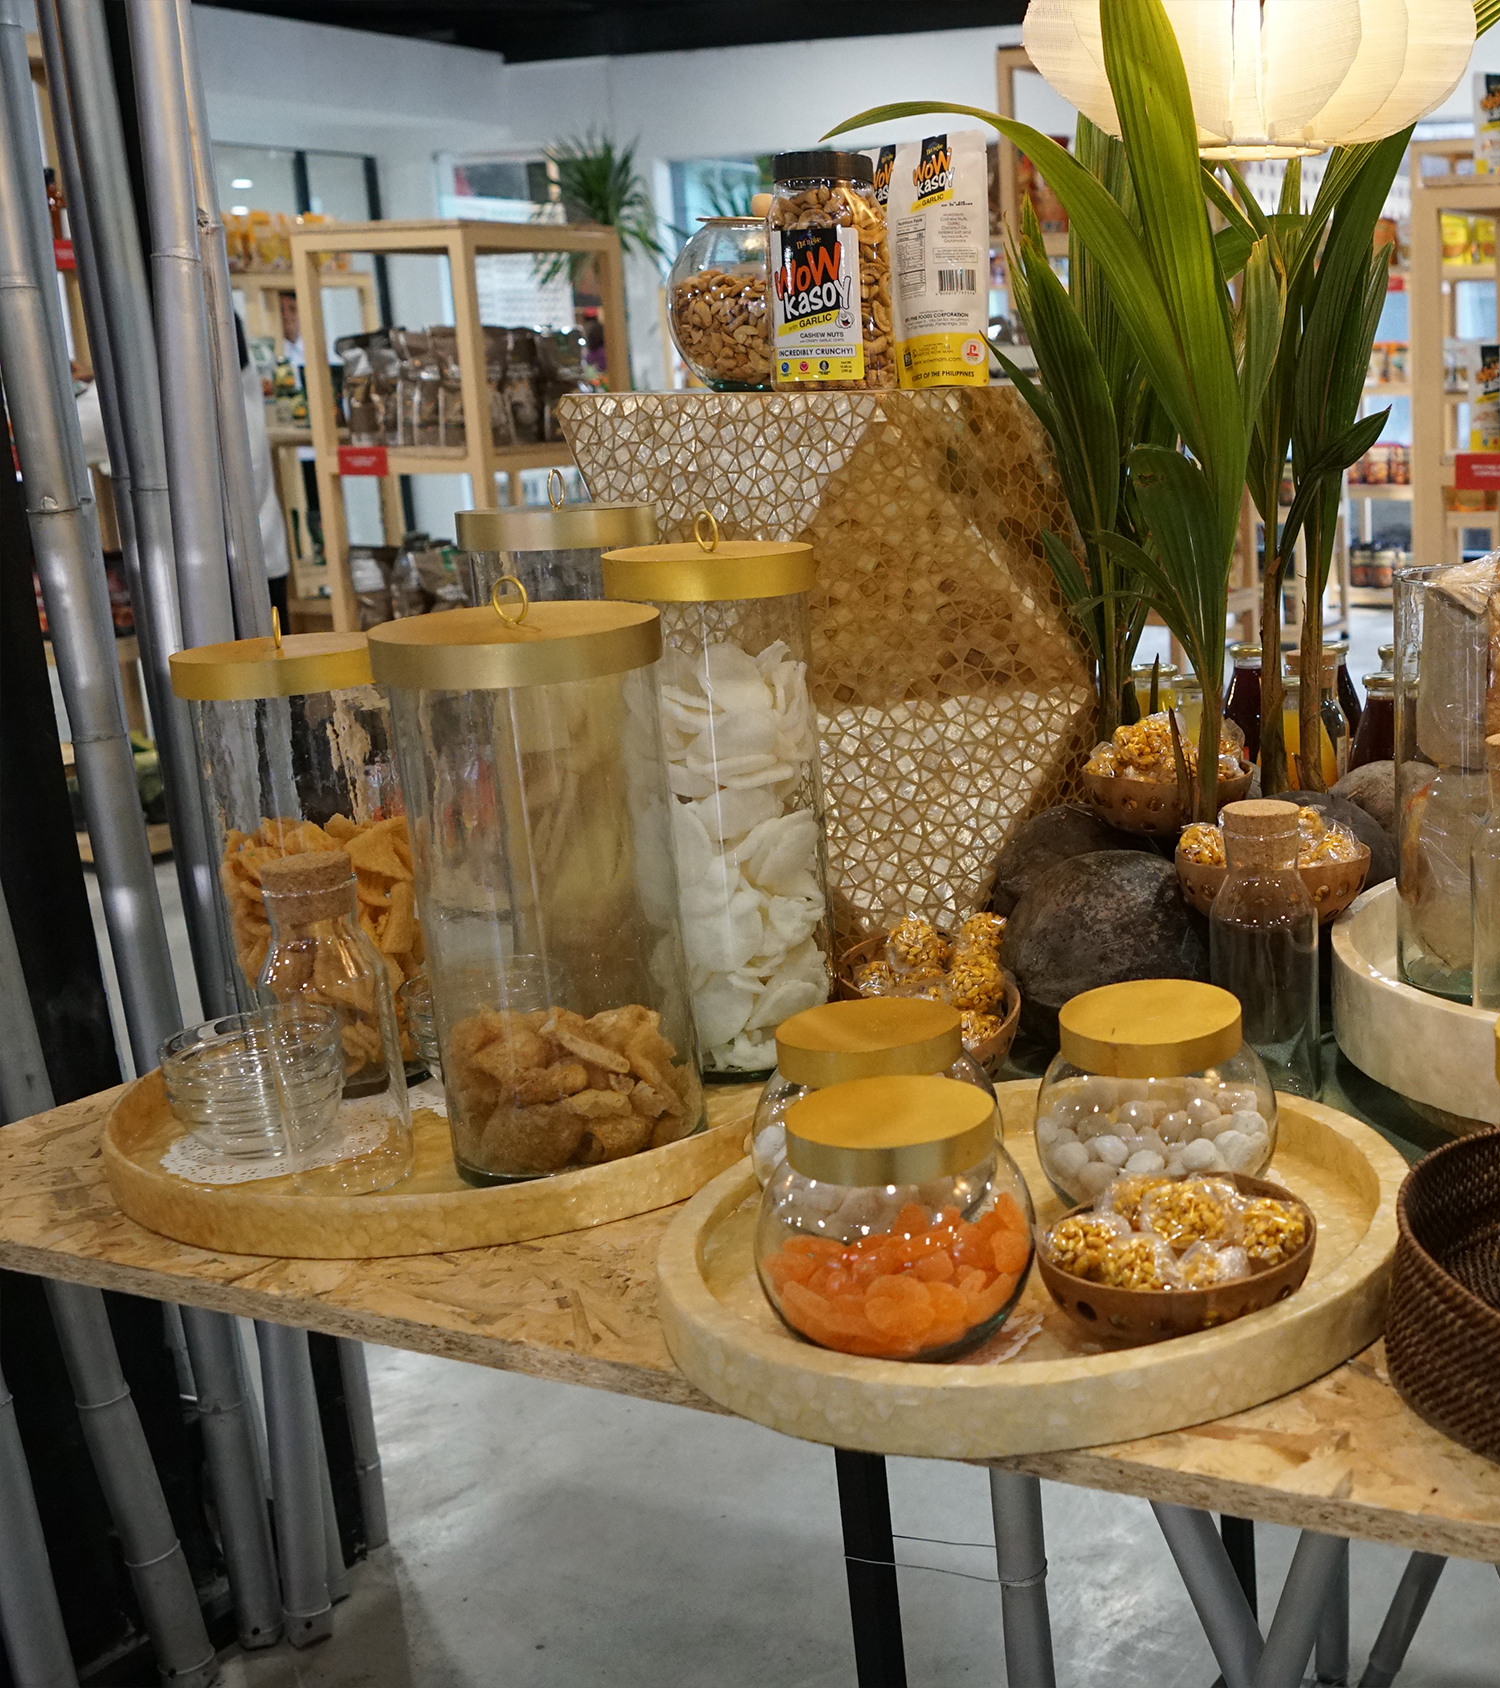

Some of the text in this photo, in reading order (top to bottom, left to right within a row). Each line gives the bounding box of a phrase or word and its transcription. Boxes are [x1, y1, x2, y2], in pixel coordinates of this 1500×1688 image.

[921, 193, 944, 207] GARLIC
[799, 313, 832, 328] GARLIC
[778, 347, 853, 357] INCREDIBLY CRUNCHY!
